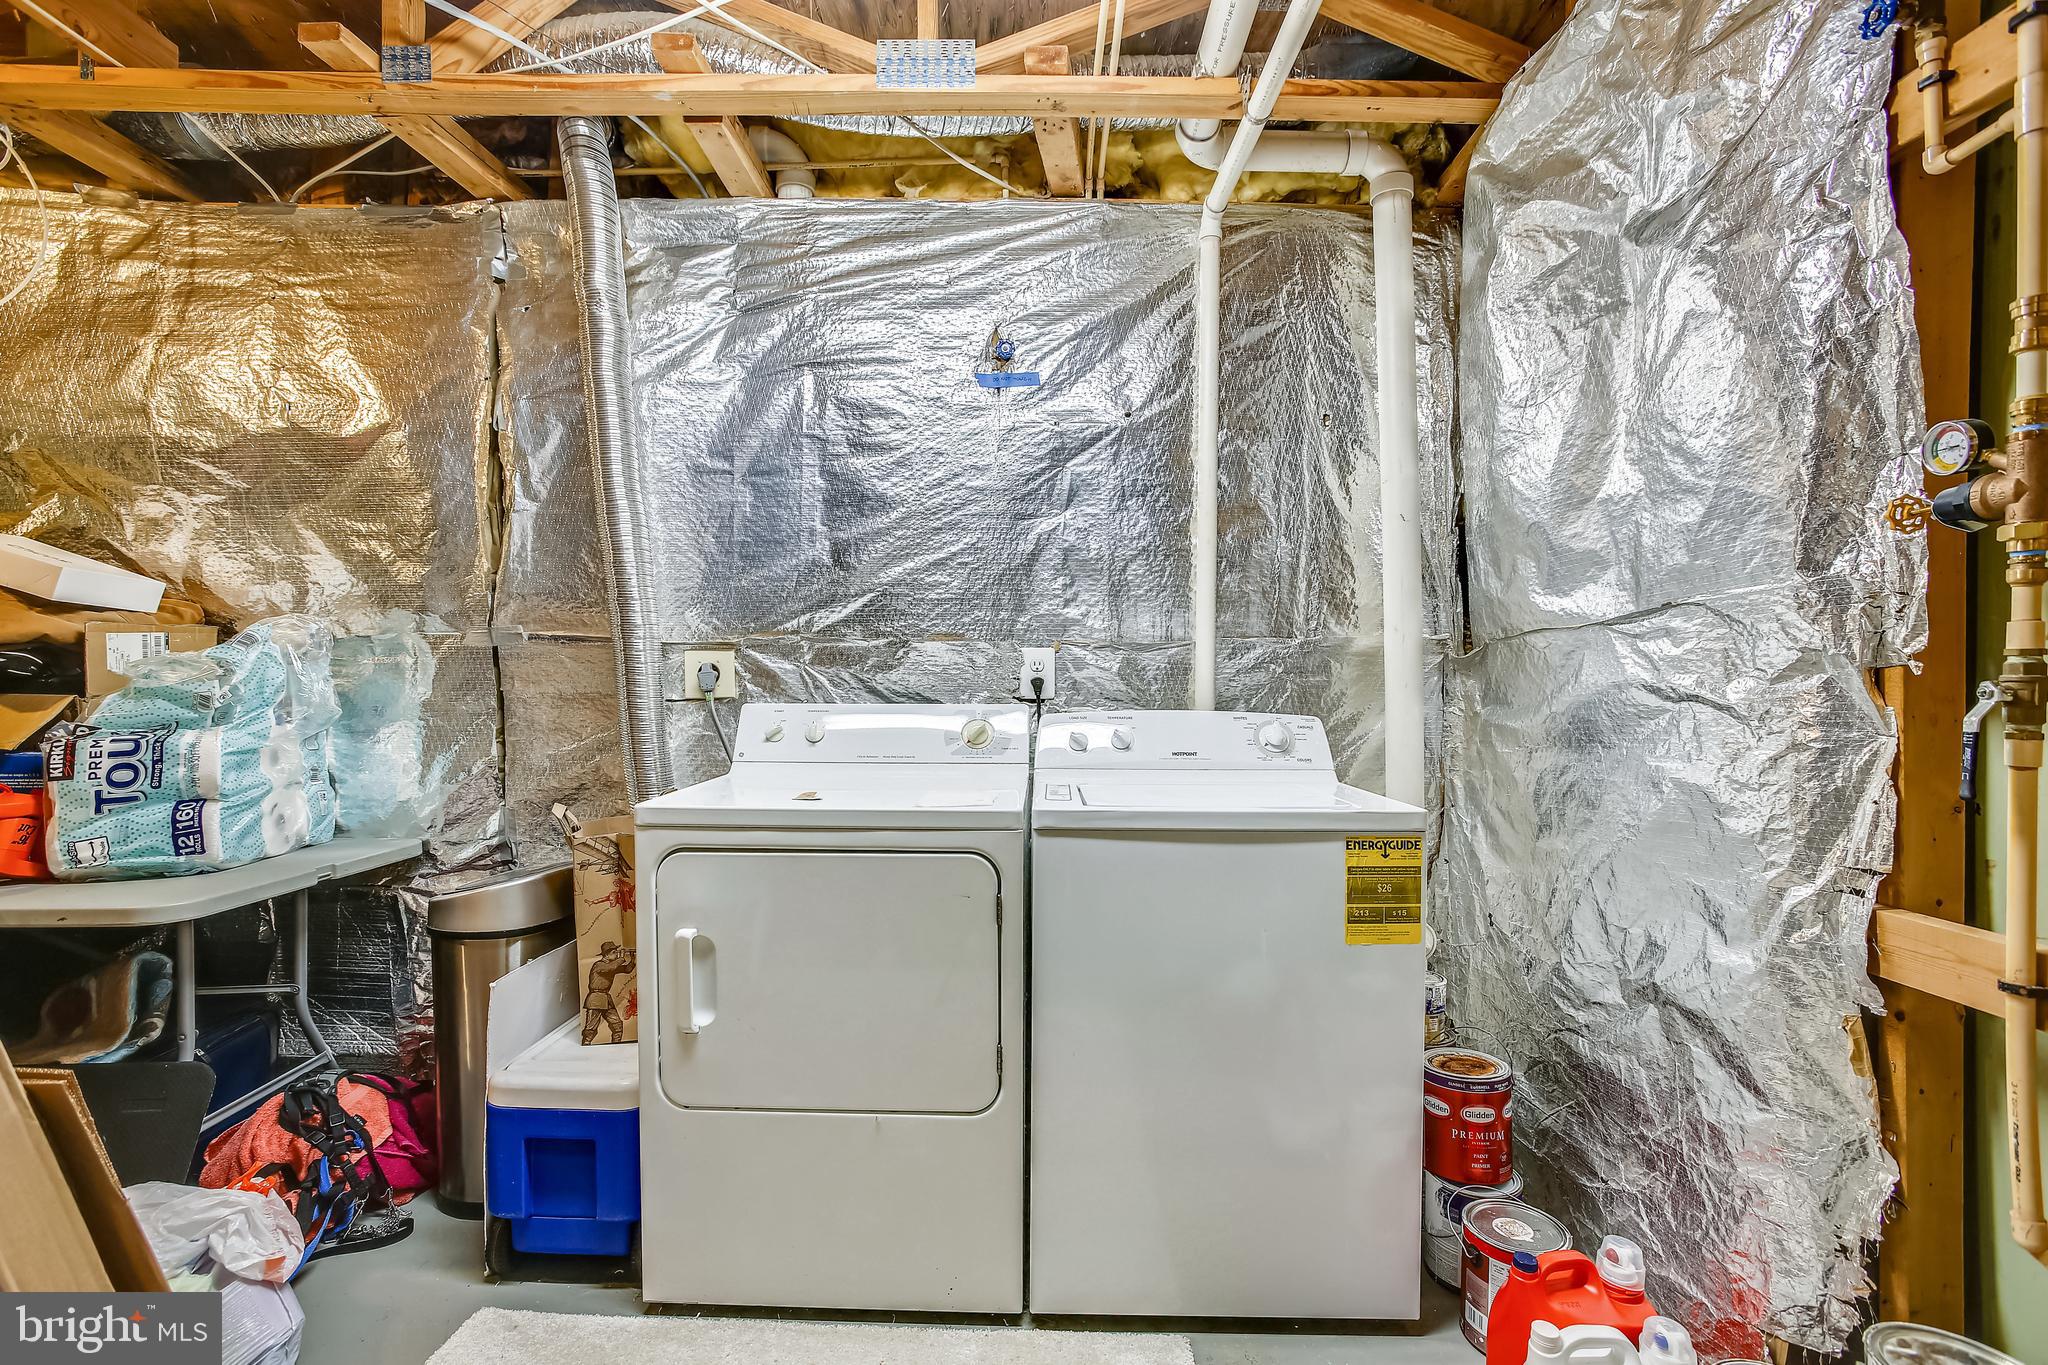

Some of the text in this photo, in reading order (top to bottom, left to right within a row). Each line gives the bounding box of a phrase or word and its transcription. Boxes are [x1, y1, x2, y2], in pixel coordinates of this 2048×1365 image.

[1217, 1, 1237, 53] PRESSURE
[49, 738, 66, 778] KIRKL
[87, 739, 103, 781] PREM
[153, 742, 161, 760] Thick
[175, 801, 197, 855] 12 160
[193, 833, 203, 853] ROLLS
[1346, 840, 1421, 851] ENERGYGUIDE
[1377, 883, 1392, 893] $26
[1424, 1098, 1449, 1114] Glidden
[1464, 1110, 1495, 1119] Glidden
[1451, 1128, 1505, 1141] PREMIUM
